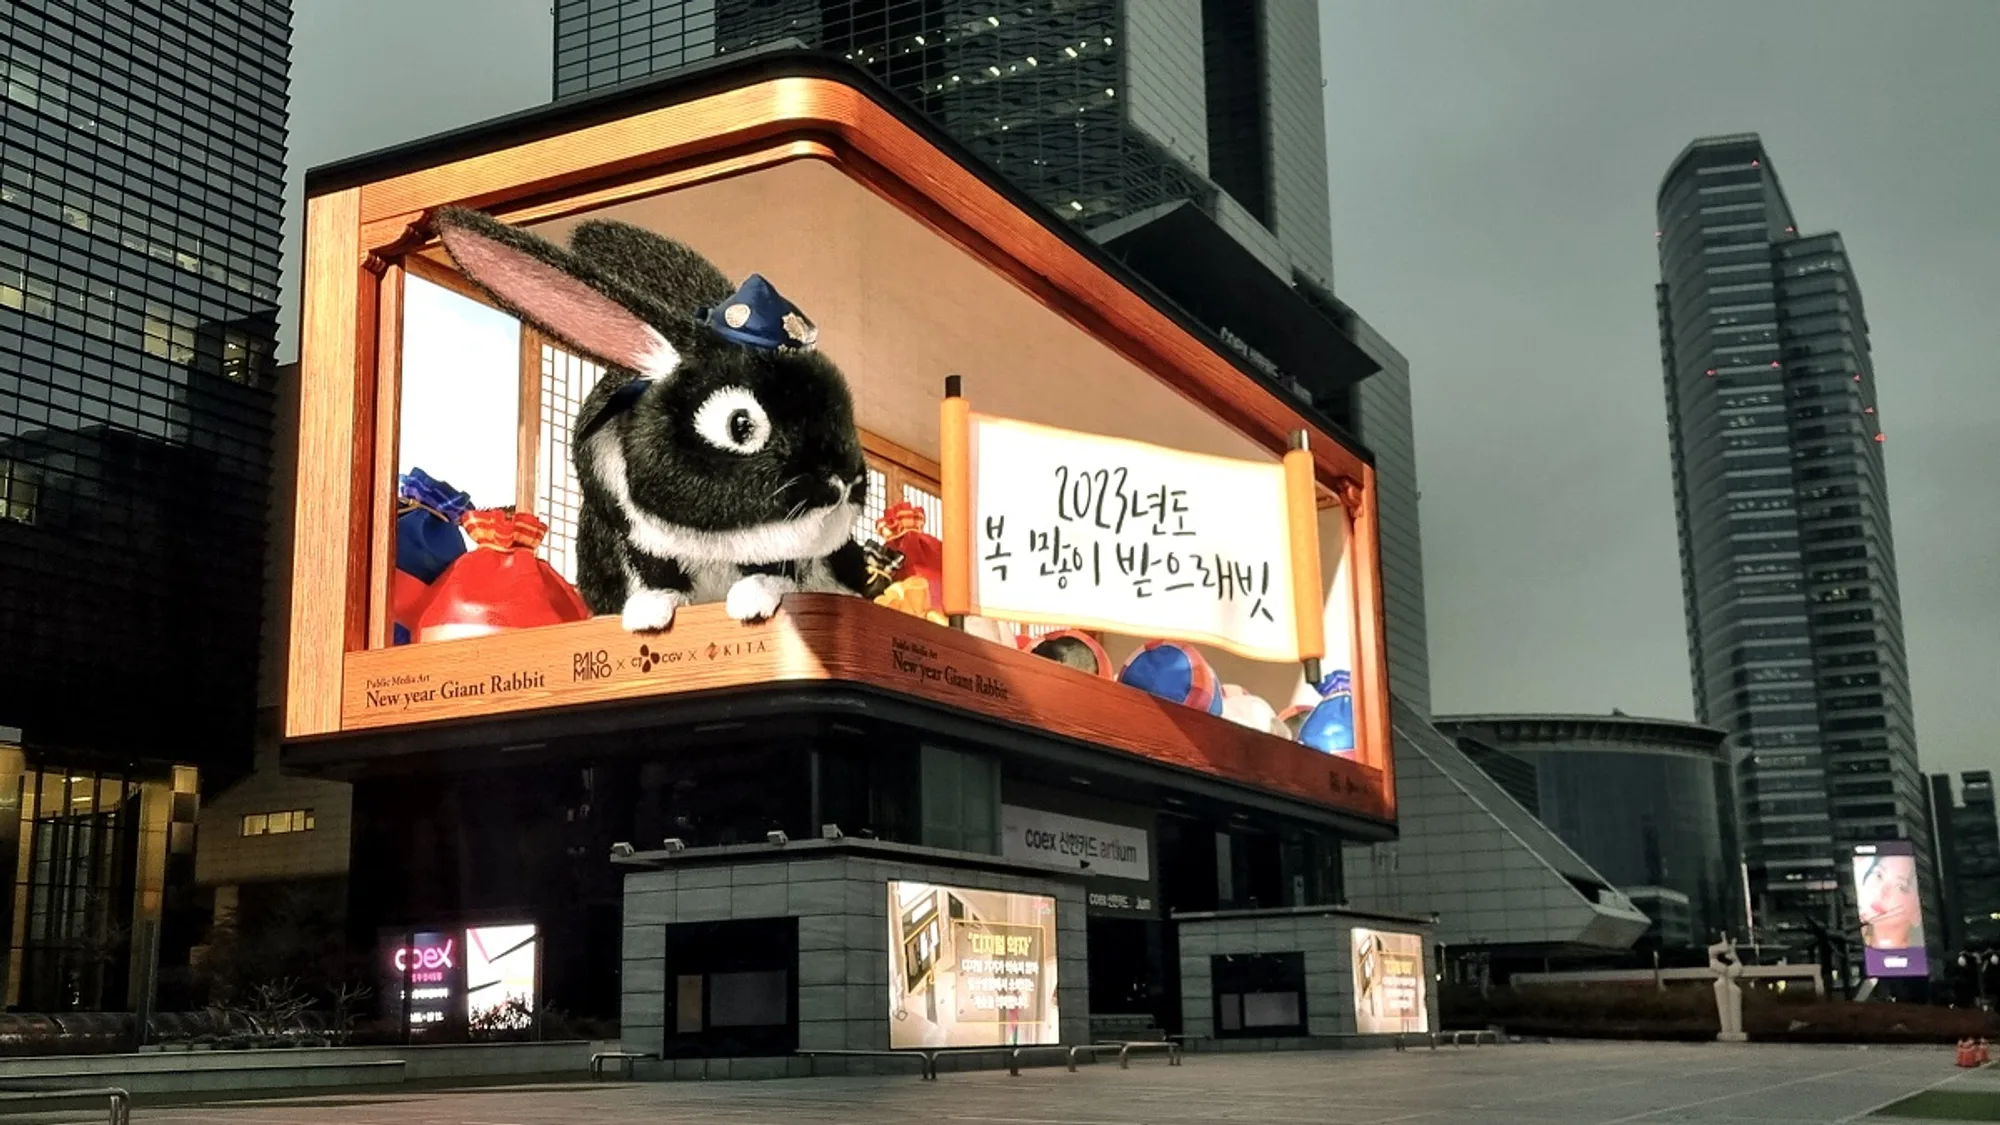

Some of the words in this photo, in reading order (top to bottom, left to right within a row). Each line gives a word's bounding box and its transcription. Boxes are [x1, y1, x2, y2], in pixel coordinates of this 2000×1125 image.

[1055, 465, 1197, 536] 2023년도
[984, 514, 1012, 582] 복
[1029, 525, 1100, 590] 많이
[1115, 540, 1275, 623] 받으래빗
[573, 649, 609, 667] PALO
[661, 651, 684, 663] CGV
[723, 640, 767, 657] KITA
[366, 678, 390, 690] Public
[392, 674, 415, 686] Media
[417, 673, 430, 683] Art
[573, 663, 613, 683] MINO
[892, 649, 917, 673] New
[919, 662, 942, 684] year
[944, 665, 973, 691] Giant
[366, 690, 400, 708] New
[403, 689, 436, 710] year
[441, 680, 486, 700] Giant
[490, 670, 545, 694] Rabbit
[1025, 828, 1056, 851] coex
[1059, 831, 1099, 858] 신한카드
[1100, 838, 1137, 864] artium
